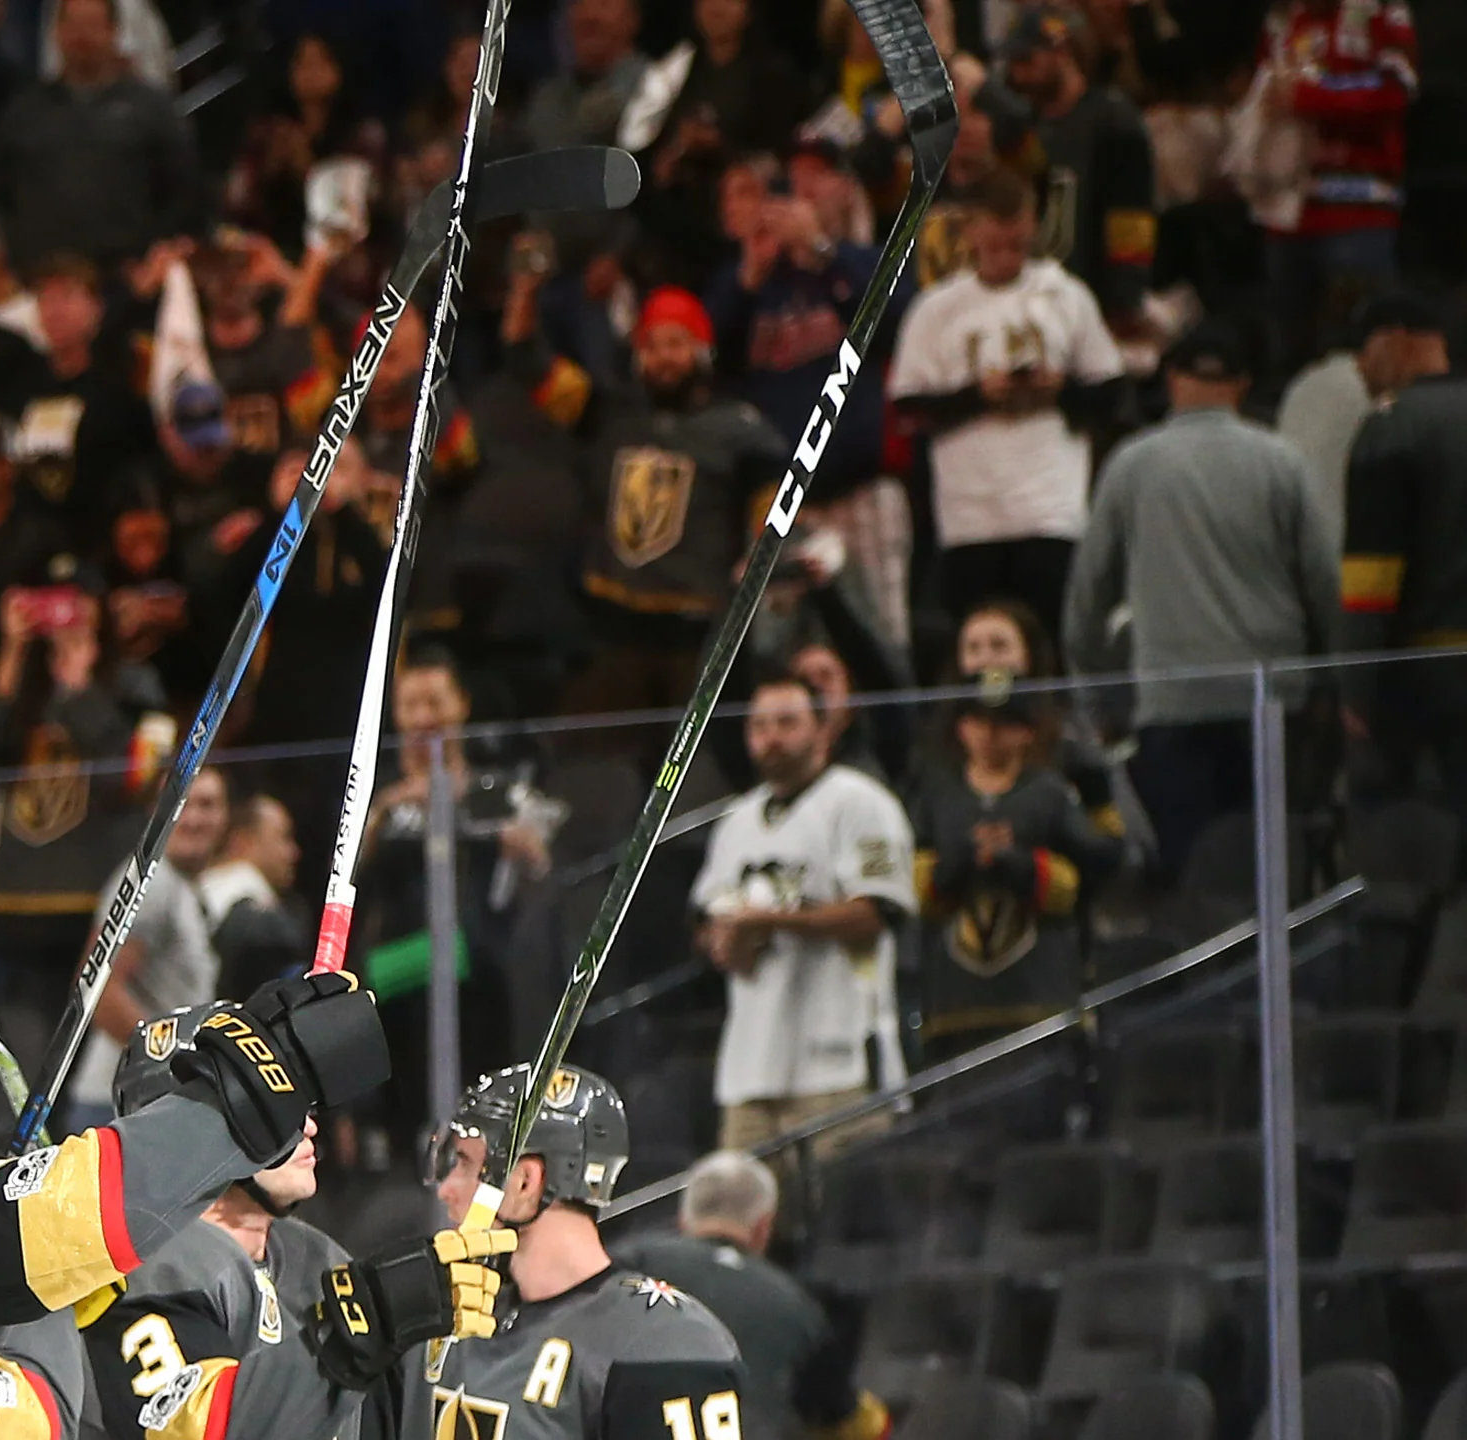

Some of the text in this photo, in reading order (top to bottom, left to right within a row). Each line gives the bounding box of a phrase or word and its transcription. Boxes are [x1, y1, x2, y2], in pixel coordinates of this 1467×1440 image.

[303, 283, 406, 491] NEXUS
[765, 338, 862, 538] CCM
[331, 762, 361, 877] EASTON
[81, 877, 135, 988] BAUER
[121, 1313, 186, 1397] 3
[522, 1337, 572, 1409] A
